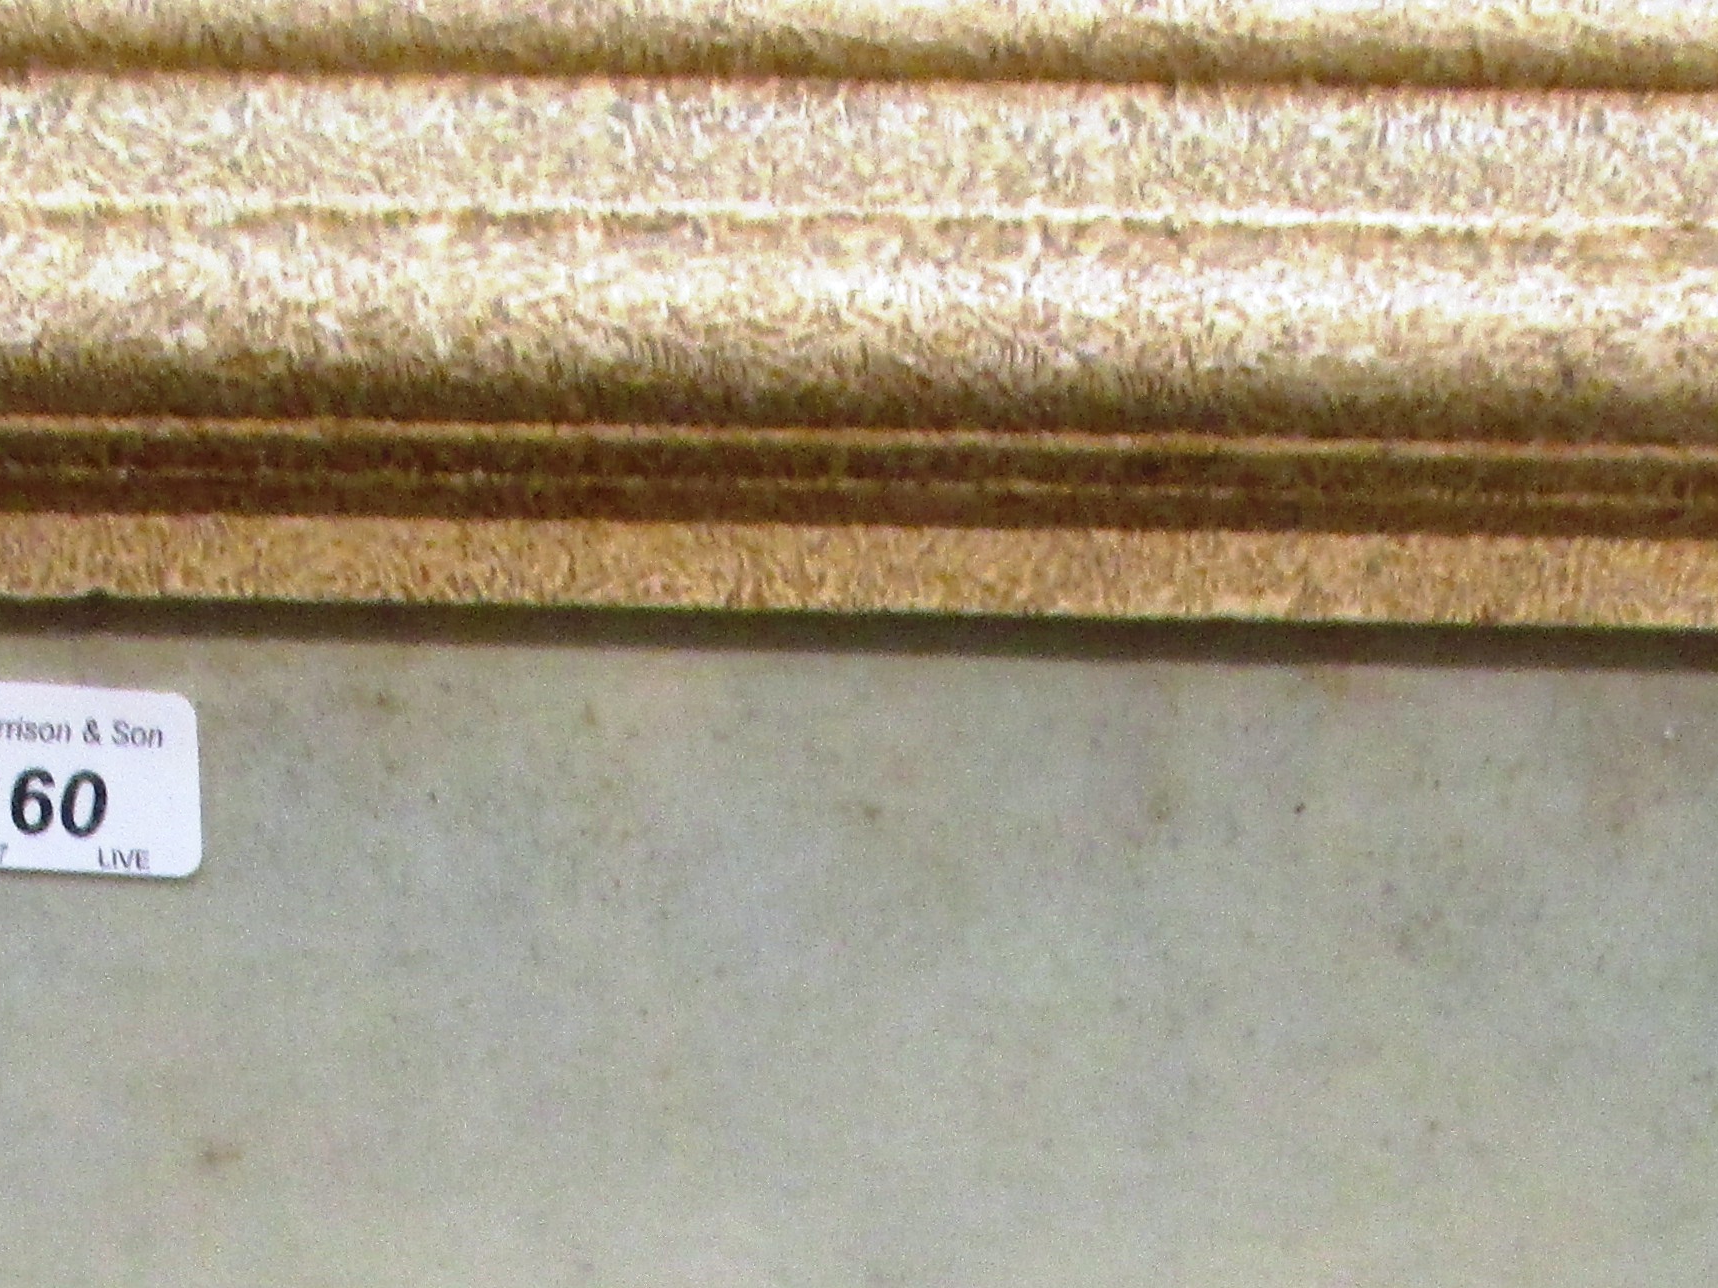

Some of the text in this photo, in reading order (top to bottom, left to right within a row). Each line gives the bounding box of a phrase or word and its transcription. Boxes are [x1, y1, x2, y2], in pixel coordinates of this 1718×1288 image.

[83, 719, 102, 746] &
[111, 720, 163, 749] Son
[98, 846, 150, 871] LIVE
